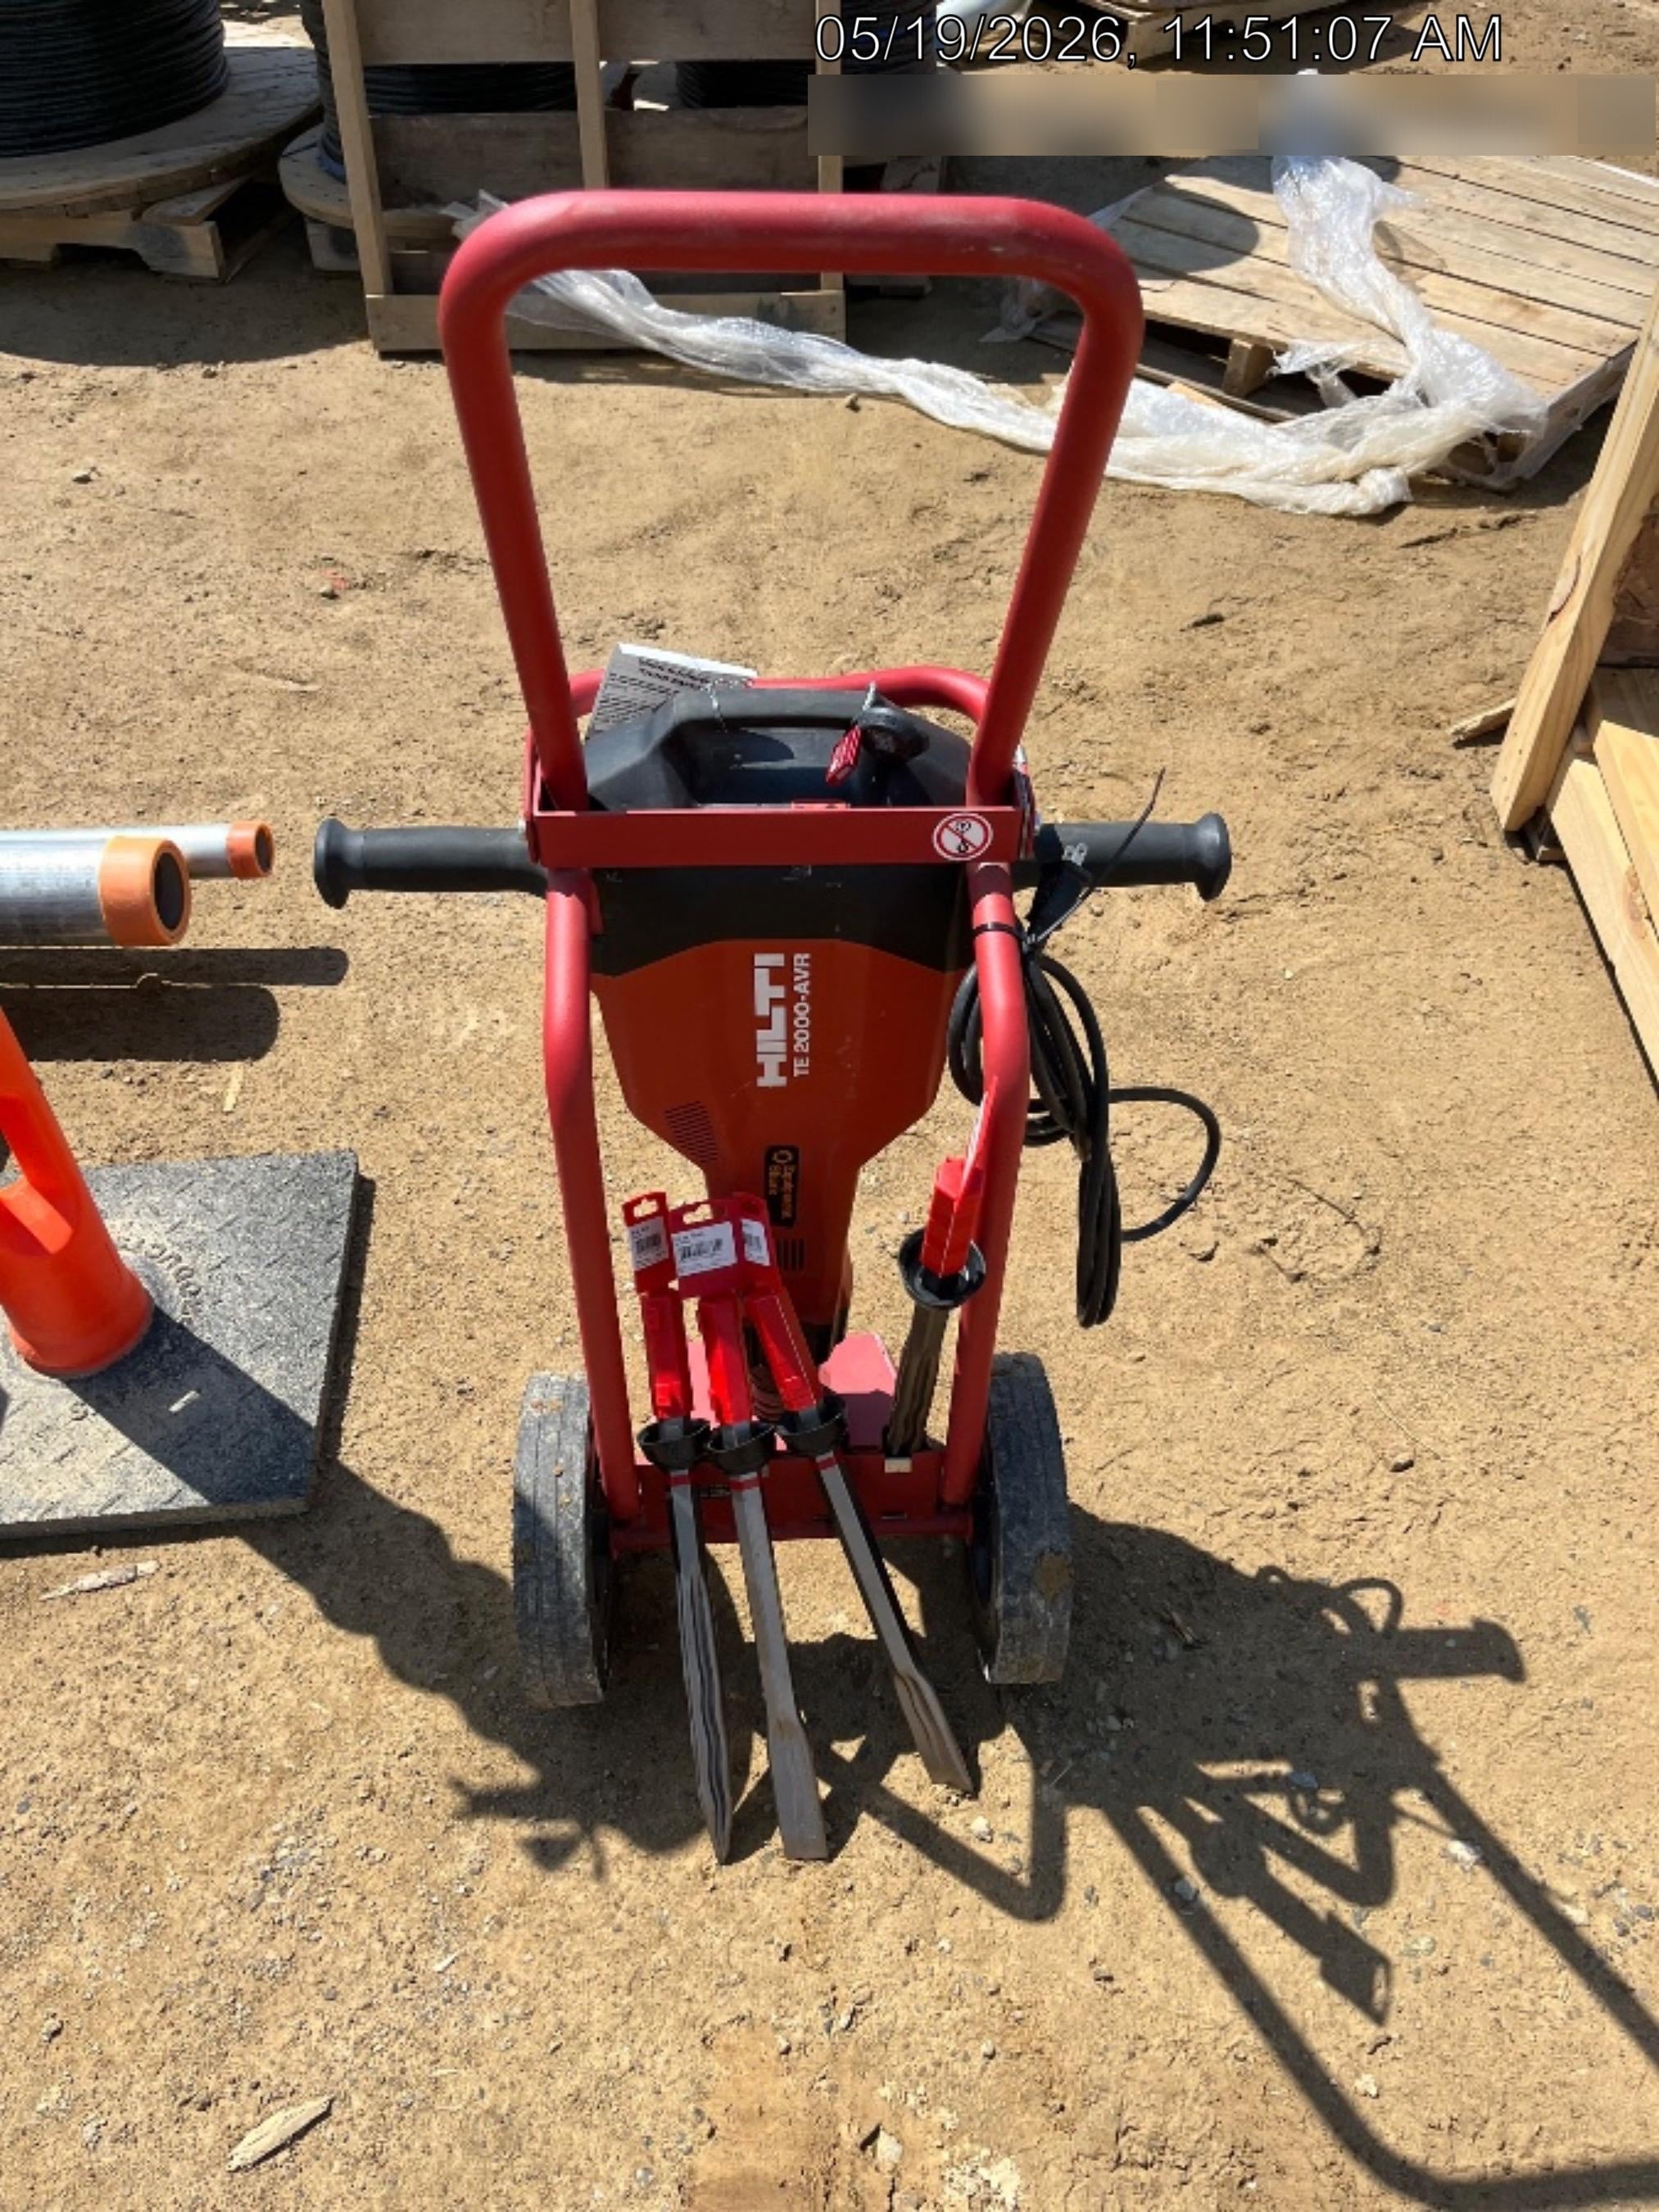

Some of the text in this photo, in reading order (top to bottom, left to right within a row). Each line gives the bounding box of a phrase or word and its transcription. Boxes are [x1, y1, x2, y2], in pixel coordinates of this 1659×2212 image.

[754, 953, 787, 1087] HILTI
[793, 953, 812, 1077] TE 2000-AVR
